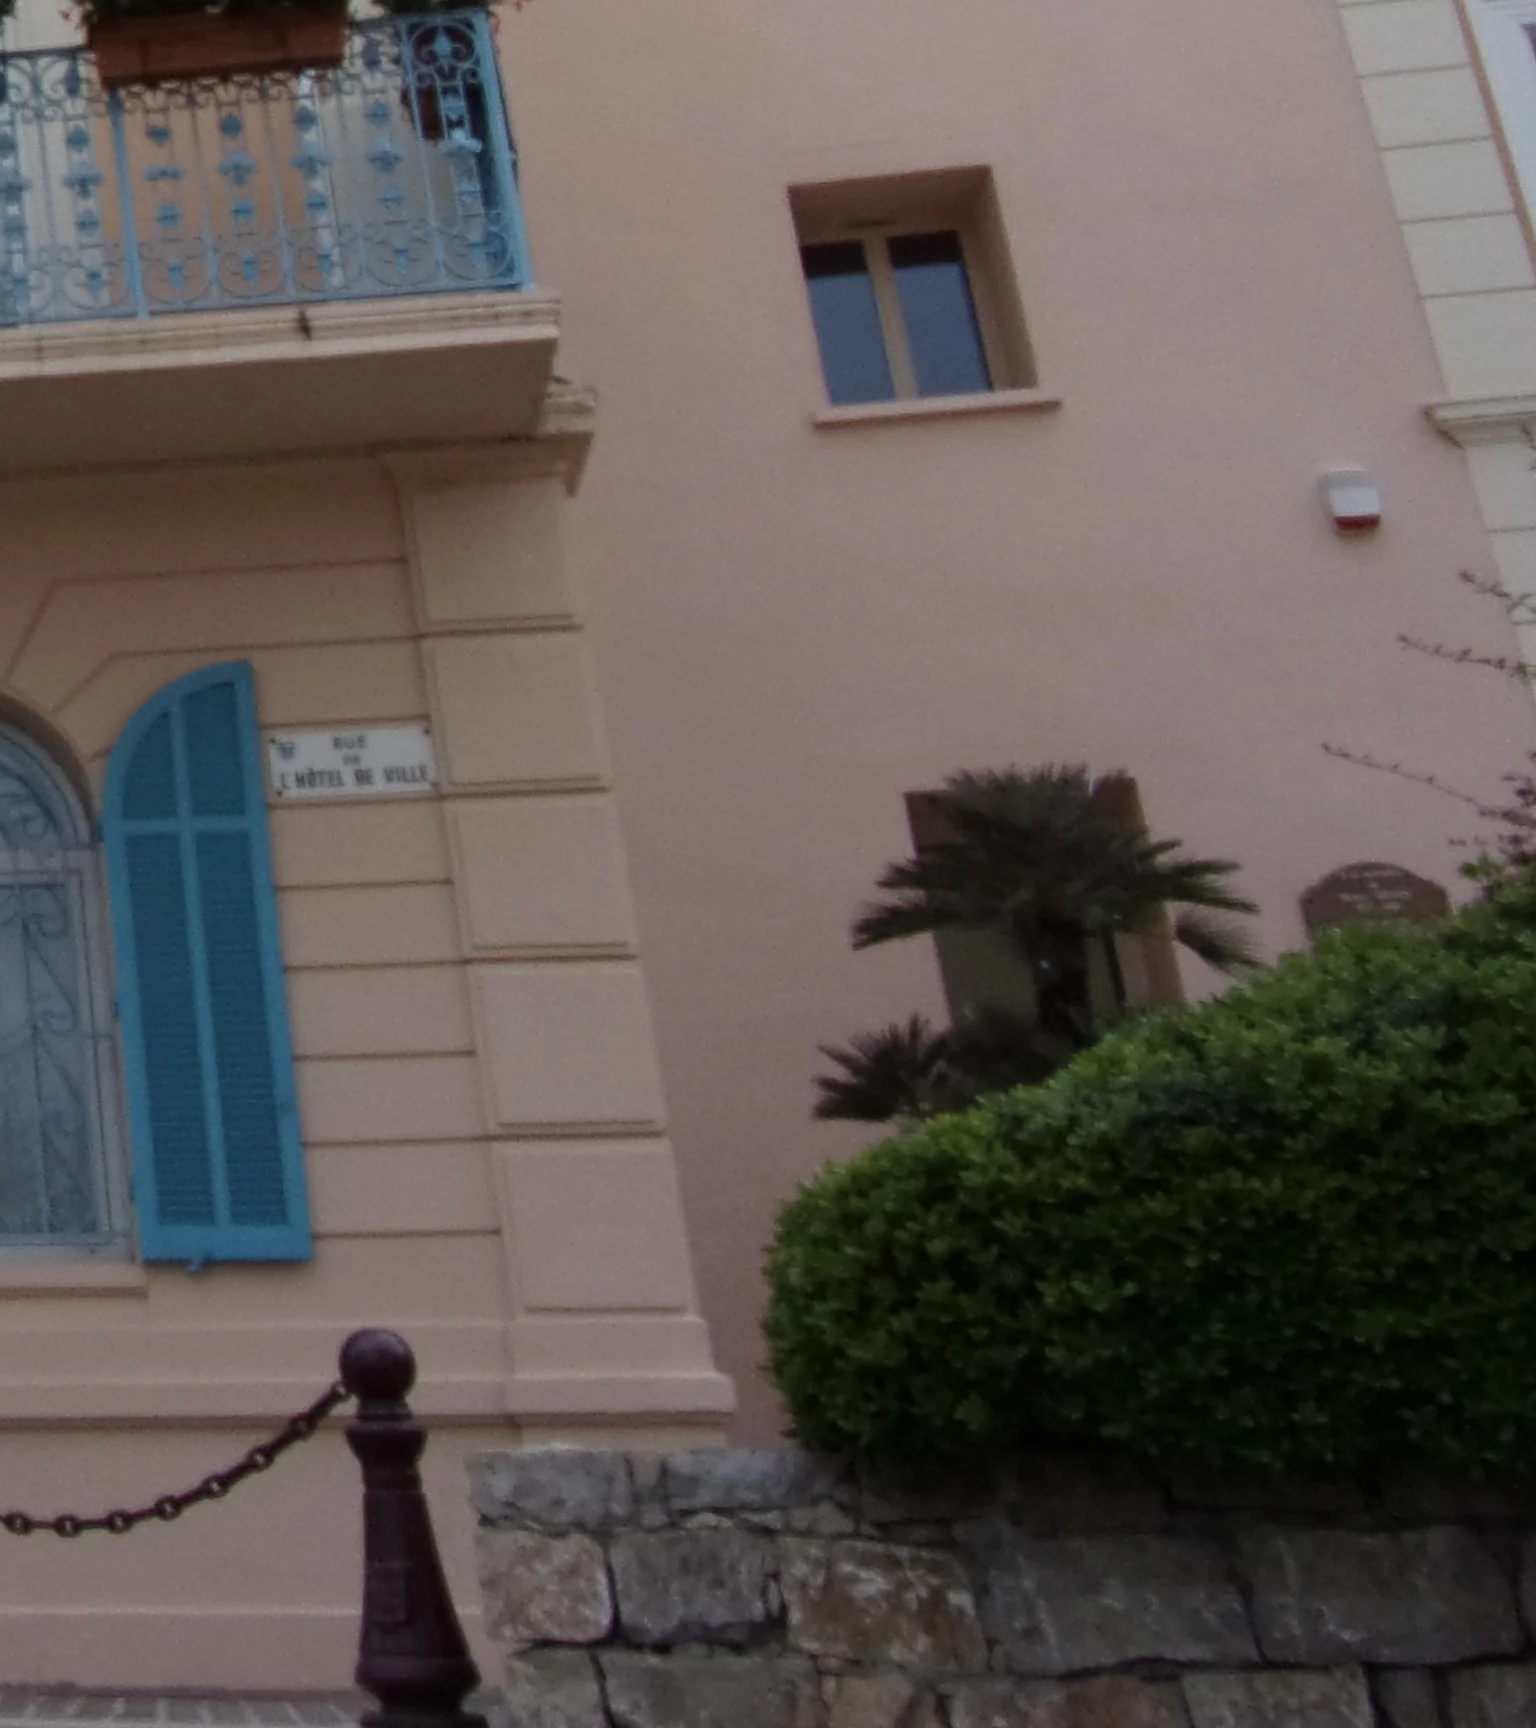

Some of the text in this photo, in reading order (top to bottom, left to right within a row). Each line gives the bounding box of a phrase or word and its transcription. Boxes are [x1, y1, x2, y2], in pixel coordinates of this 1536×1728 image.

[332, 734, 367, 750] RUE
[354, 767, 374, 786] DE
[383, 764, 428, 784] VILLE
